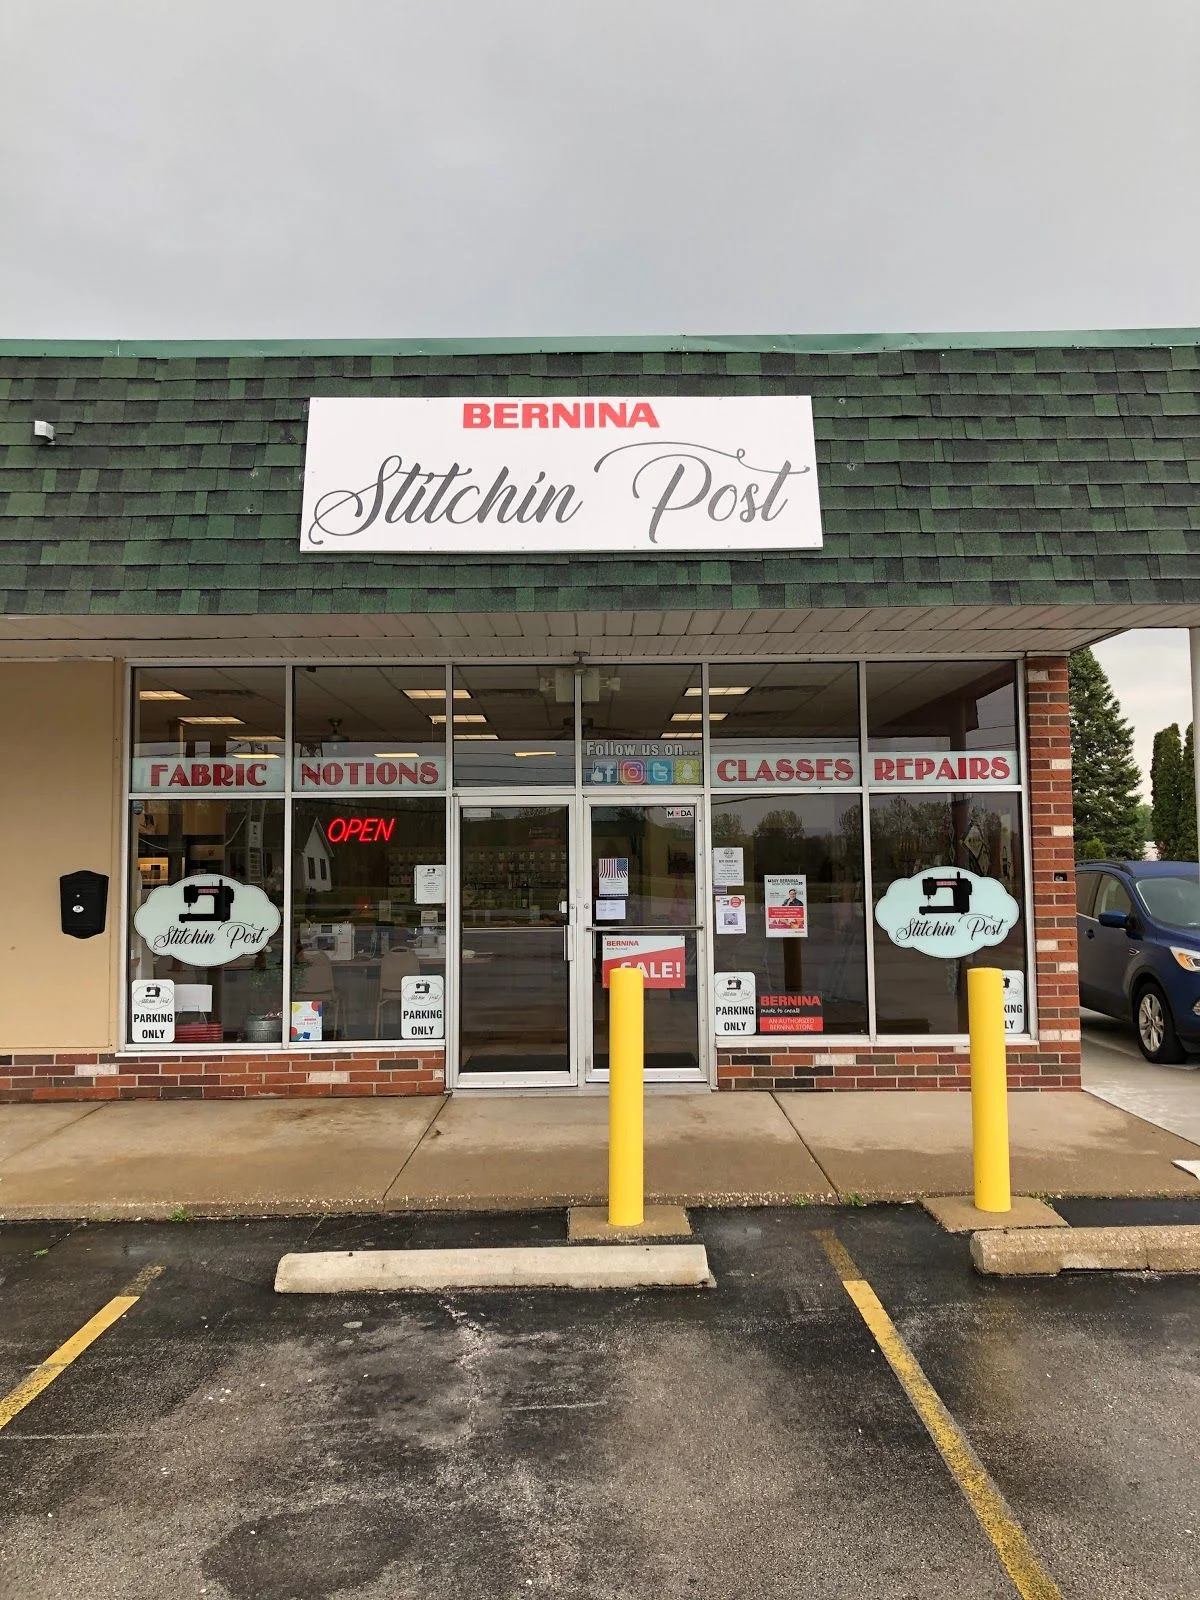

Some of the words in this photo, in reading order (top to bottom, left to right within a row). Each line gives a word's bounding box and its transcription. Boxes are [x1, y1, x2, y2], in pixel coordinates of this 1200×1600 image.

[462, 402, 660, 429] BERNINA
[308, 455, 583, 545] Stitchin
[594, 441, 811, 544] Post
[586, 741, 637, 756] Follow
[641, 744, 659, 756] us
[150, 763, 267, 787] FABRIC
[301, 762, 439, 786] NOTIONS
[716, 758, 854, 782] CLASSES
[874, 757, 1011, 780] REPAIRS
[327, 817, 396, 843] OPEN
[153, 925, 216, 950] Stitchin
[218, 921, 269, 949] Post
[896, 918, 957, 943] Stitchin
[958, 913, 1008, 941] Post
[715, 1006, 754, 1015] PARKING
[760, 995, 821, 1006] BERNINA
[133, 1013, 173, 1023] PARKING
[403, 1010, 442, 1019] PARKING
[142, 1029, 165, 1039] ONLY
[411, 1026, 434, 1035] ONLY
[724, 1022, 747, 1031] ONLY
